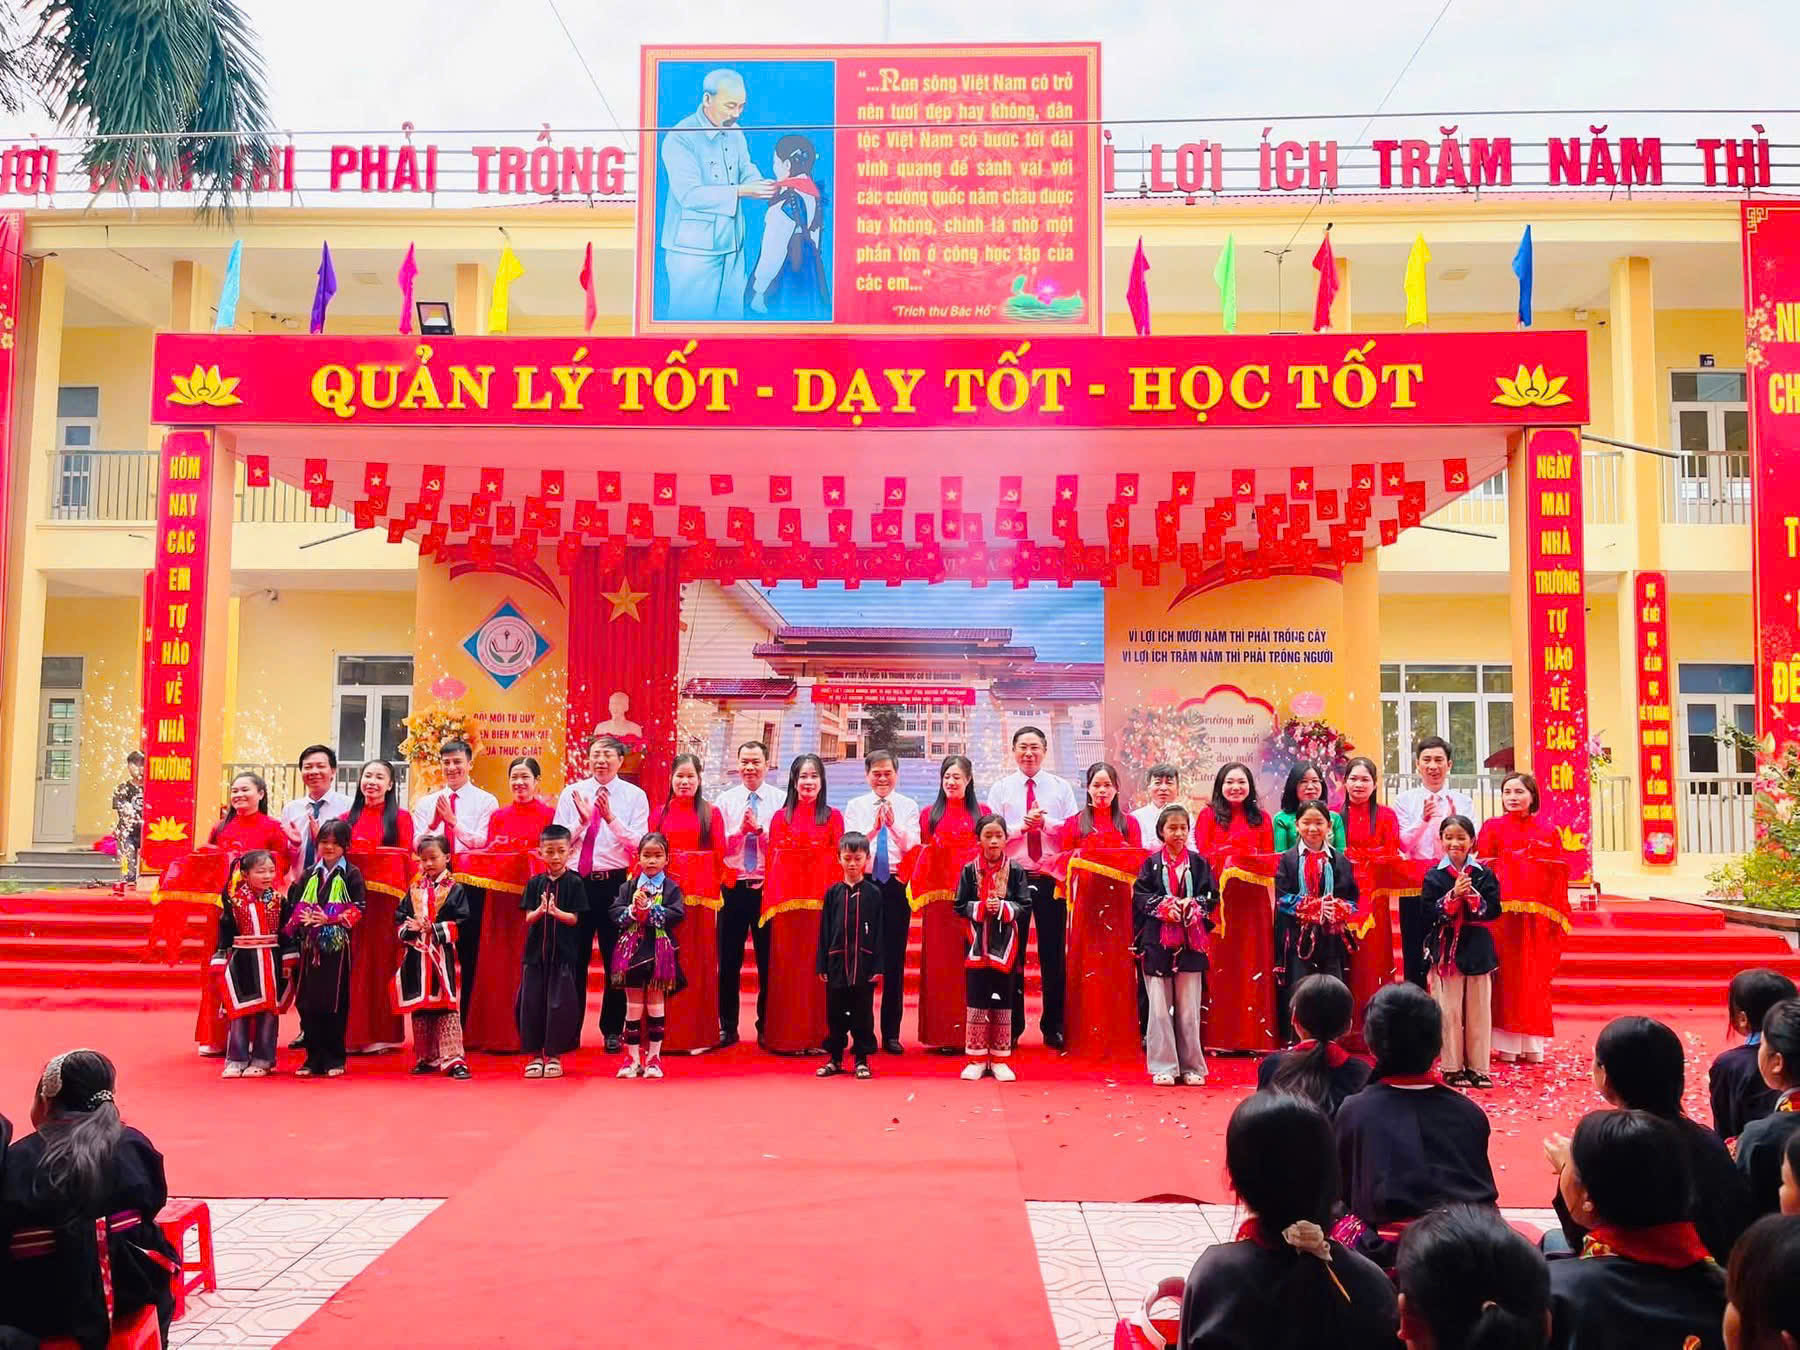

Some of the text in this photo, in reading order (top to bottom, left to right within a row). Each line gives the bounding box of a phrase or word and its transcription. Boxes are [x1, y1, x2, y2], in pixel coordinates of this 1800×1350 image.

[923, 74, 957, 93] sông
[961, 74, 989, 94] Việt
[993, 75, 1026, 90] Nam
[1031, 74, 1049, 90] có
[1054, 71, 1073, 90] trở
[857, 103, 884, 120] nên
[926, 103, 952, 123] đẹp
[959, 103, 984, 121] hay
[1048, 102, 1073, 120] dân
[857, 131, 881, 152] tộc
[887, 131, 913, 152] Việt
[920, 132, 953, 147] Nam
[959, 131, 977, 147] có
[330, 121, 438, 194] PHẢI
[1151, 139, 1222, 205] LỢI
[1259, 126, 1338, 191] ÍCH
[1372, 124, 1512, 188] TRĂM
[1548, 123, 1662, 188] NĂM
[1696, 123, 1770, 188] THÌ
[857, 160, 888, 176] vinh
[897, 161, 942, 178] quang
[977, 160, 1011, 176] sánh
[1021, 160, 1041, 176] vai
[857, 190, 882, 204] các
[857, 217, 882, 234] hay
[992, 216, 1005, 232] là
[944, 246, 978, 263] công
[985, 247, 1011, 264] học
[856, 274, 882, 290] các
[310, 339, 1424, 426] QUẢN LÝ TỐT - DẠY TỐT - HỌC TỐT
[169, 451, 201, 480] HÔM
[1536, 450, 1573, 479] NGÀY
[169, 493, 198, 517] NAY
[1540, 492, 1571, 516] MAI
[167, 524, 196, 553] CÁC
[1540, 525, 1572, 555] NHÀ
[168, 567, 191, 591] EM
[1534, 563, 1581, 595] TRƯỜNG
[168, 603, 189, 633] TỰ
[1547, 607, 1568, 638] TỰ
[161, 637, 190, 665] HÀO
[1129, 628, 1138, 643] VÌ
[1141, 630, 1155, 646] LỢI
[1158, 628, 1174, 643] ÍCH
[1177, 629, 1202, 643] MƯỜI
[1205, 628, 1227, 643] NĂM
[1230, 628, 1245, 643] THÌ
[1248, 628, 1270, 643] PHẢI
[1307, 628, 1326, 643] CÂY
[1123, 648, 1131, 663] VÌ
[1134, 650, 1149, 665] LỢI
[1152, 648, 1168, 663] ÍCH
[1170, 648, 1197, 663] TRĂM
[1201, 648, 1223, 663] NĂM
[1226, 648, 1241, 663] THÌ
[1244, 648, 1266, 663] PHẢI
[1304, 648, 1333, 663] NGƯỜI
[1544, 642, 1574, 671] HÀO
[165, 671, 183, 704] VỀ
[1551, 678, 1570, 711] VỀ
[158, 714, 185, 742] NHÀ
[1546, 720, 1576, 749] CÁC
[149, 750, 192, 781] TRƯỜNG
